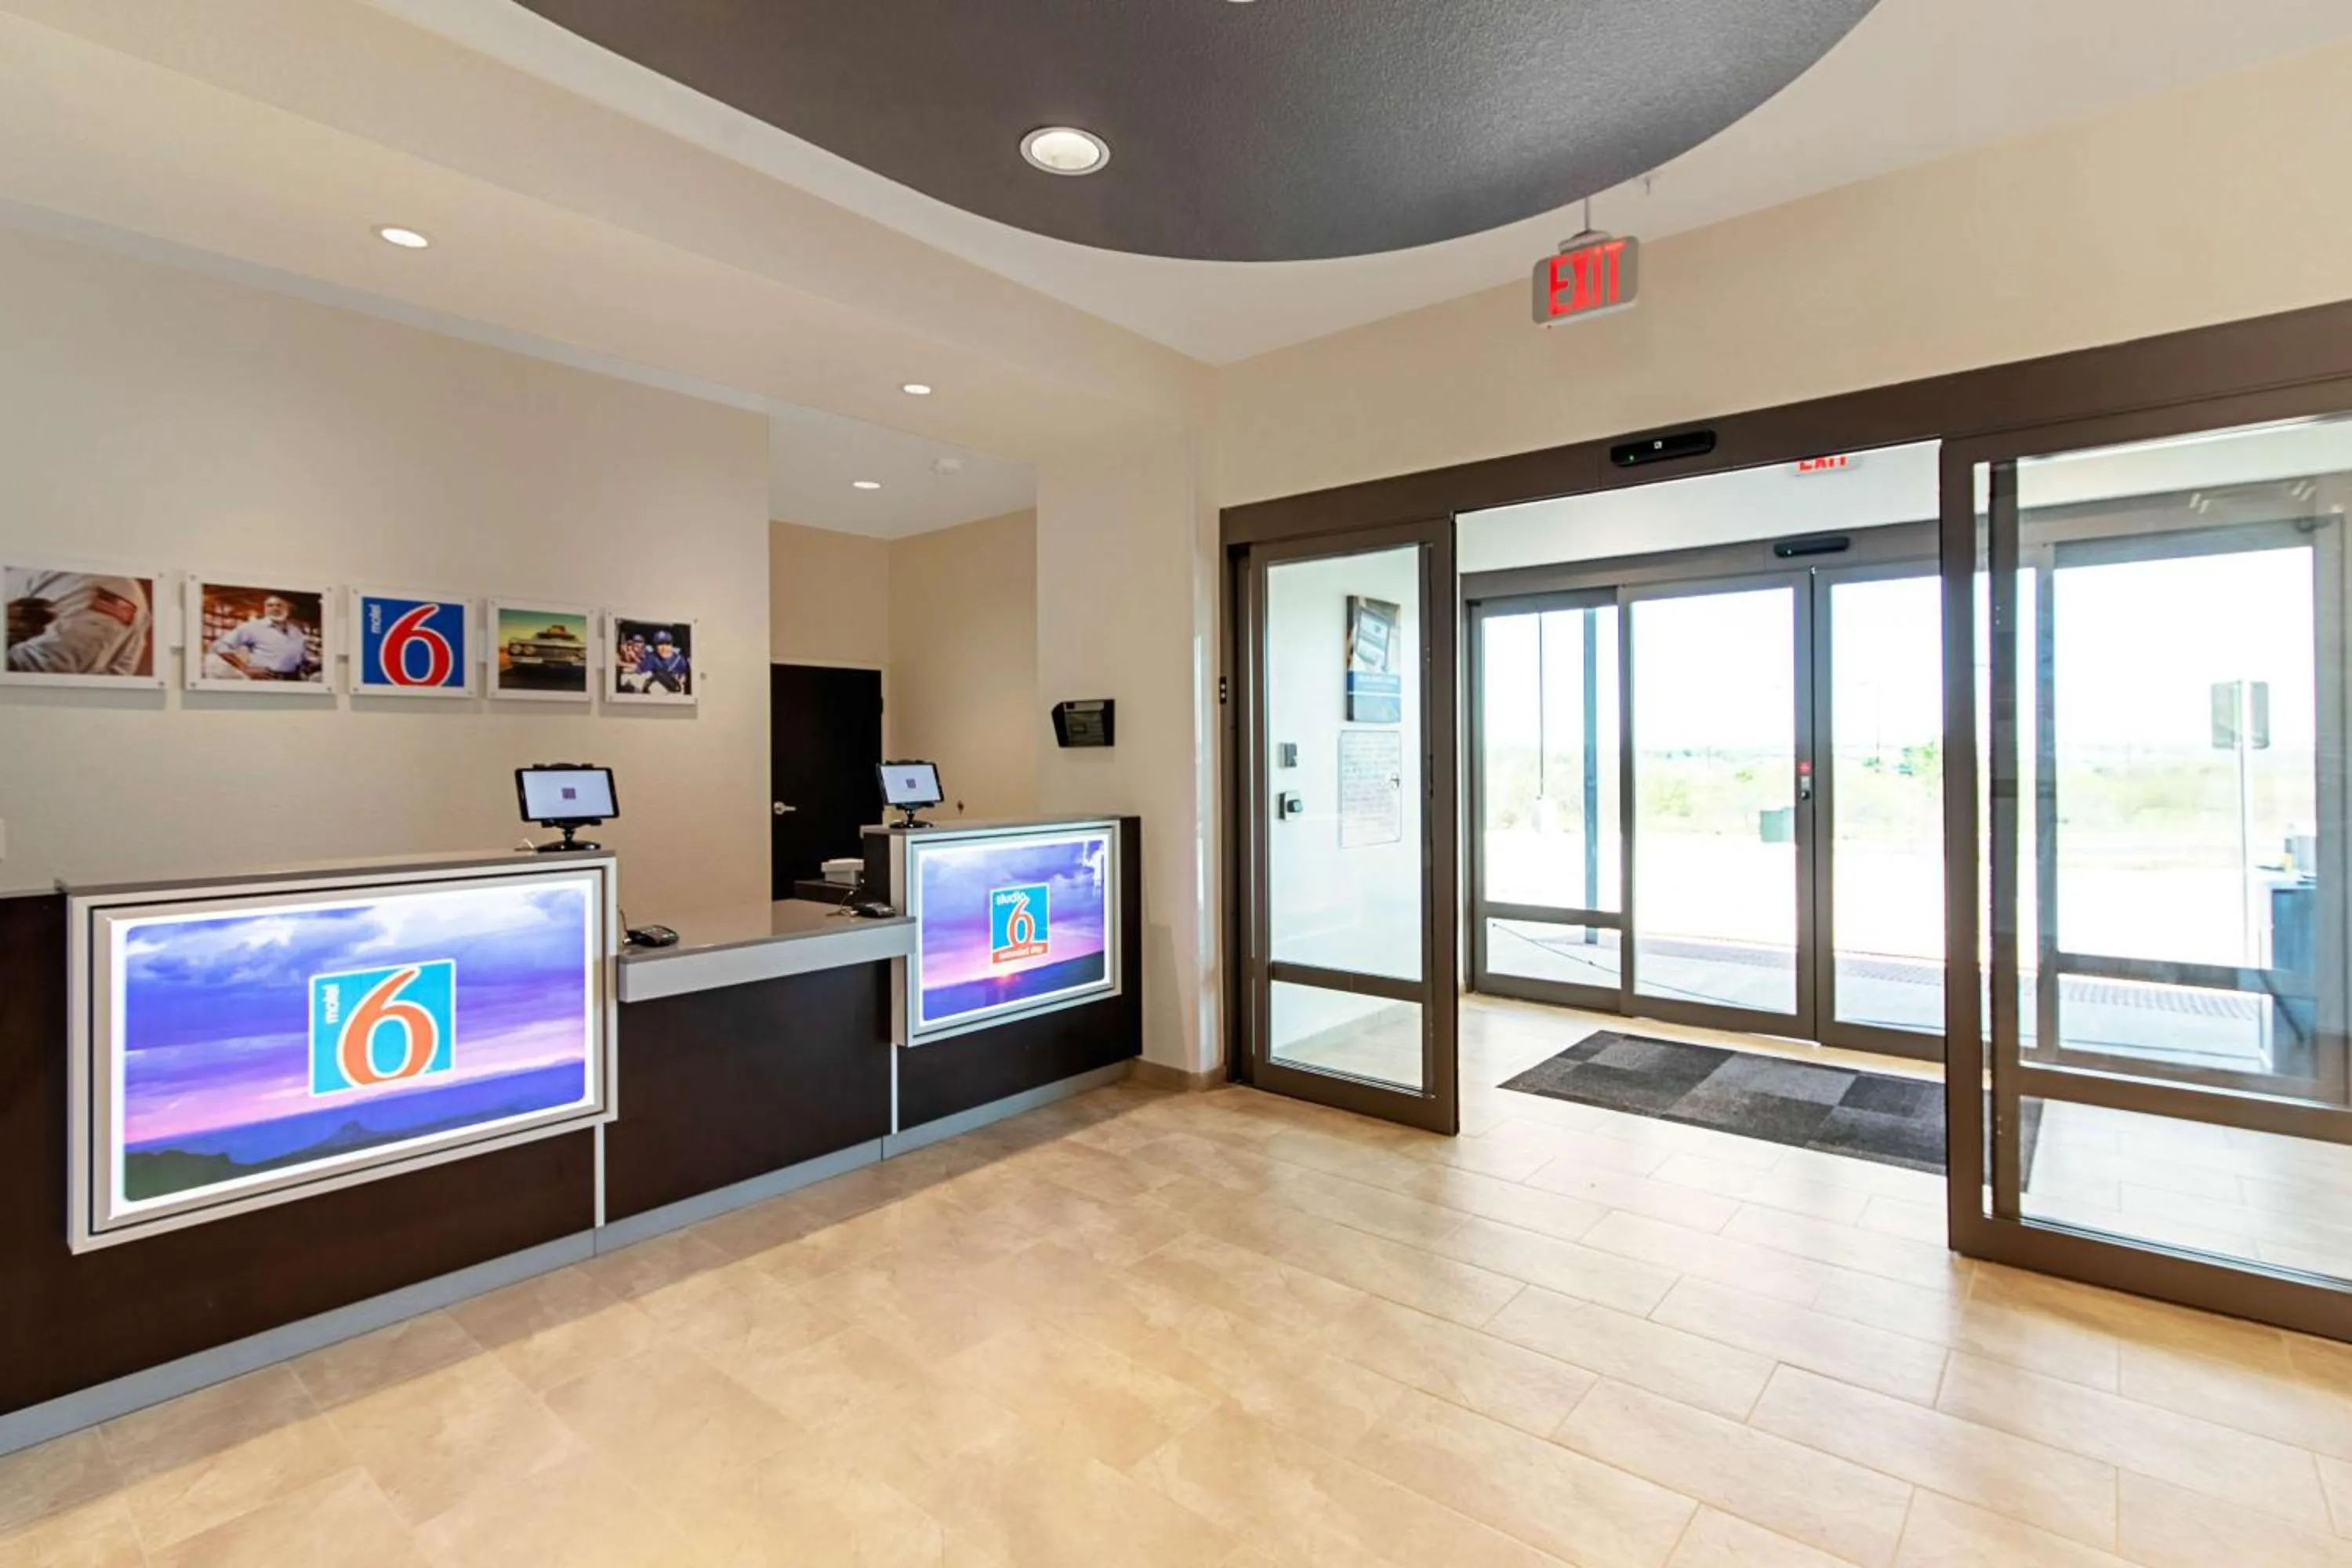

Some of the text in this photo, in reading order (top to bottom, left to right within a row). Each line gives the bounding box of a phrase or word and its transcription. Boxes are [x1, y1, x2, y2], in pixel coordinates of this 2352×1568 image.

[1549, 239, 1627, 316] EXIT
[368, 604, 381, 633] motel
[379, 604, 454, 687] 6
[1007, 898, 1035, 946] 6
[336, 967, 439, 1086] 6
